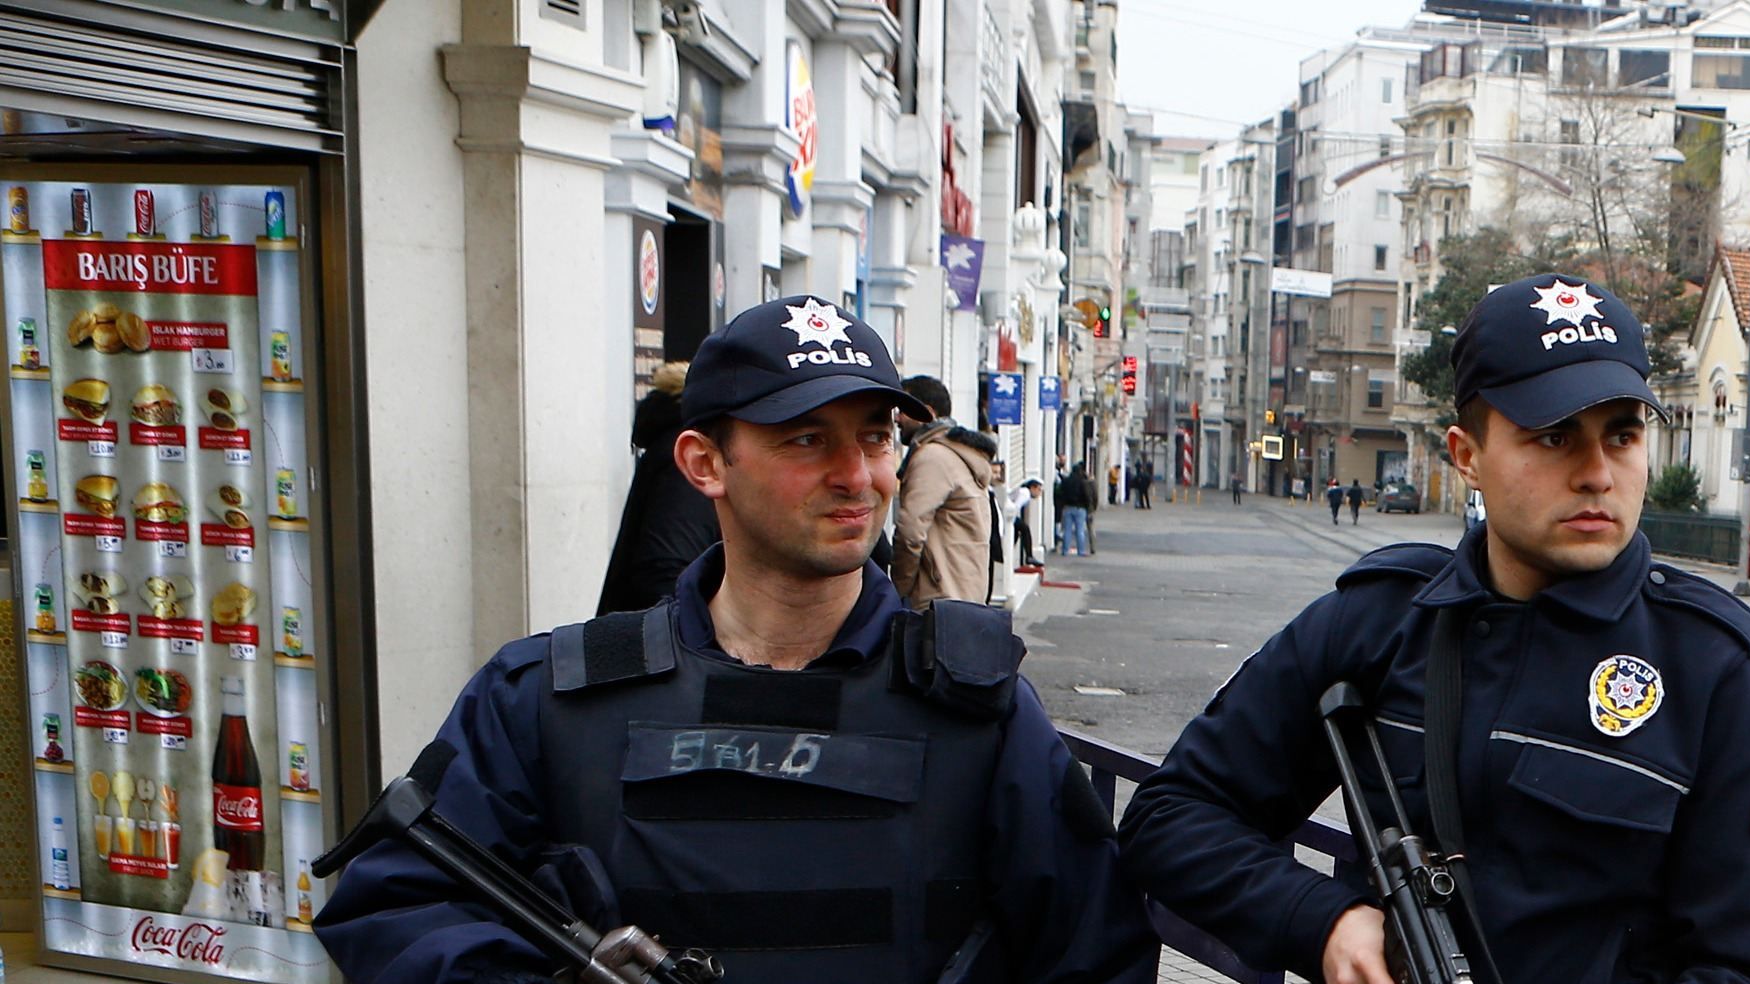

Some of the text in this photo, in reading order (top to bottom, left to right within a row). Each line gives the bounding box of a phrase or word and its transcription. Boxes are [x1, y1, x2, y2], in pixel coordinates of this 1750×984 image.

[77, 247, 219, 289] BARIŞ BÜFE
[176, 326, 225, 336] HAMBURGER
[1541, 321, 1618, 350] POLİS
[786, 347, 873, 369] POLİS
